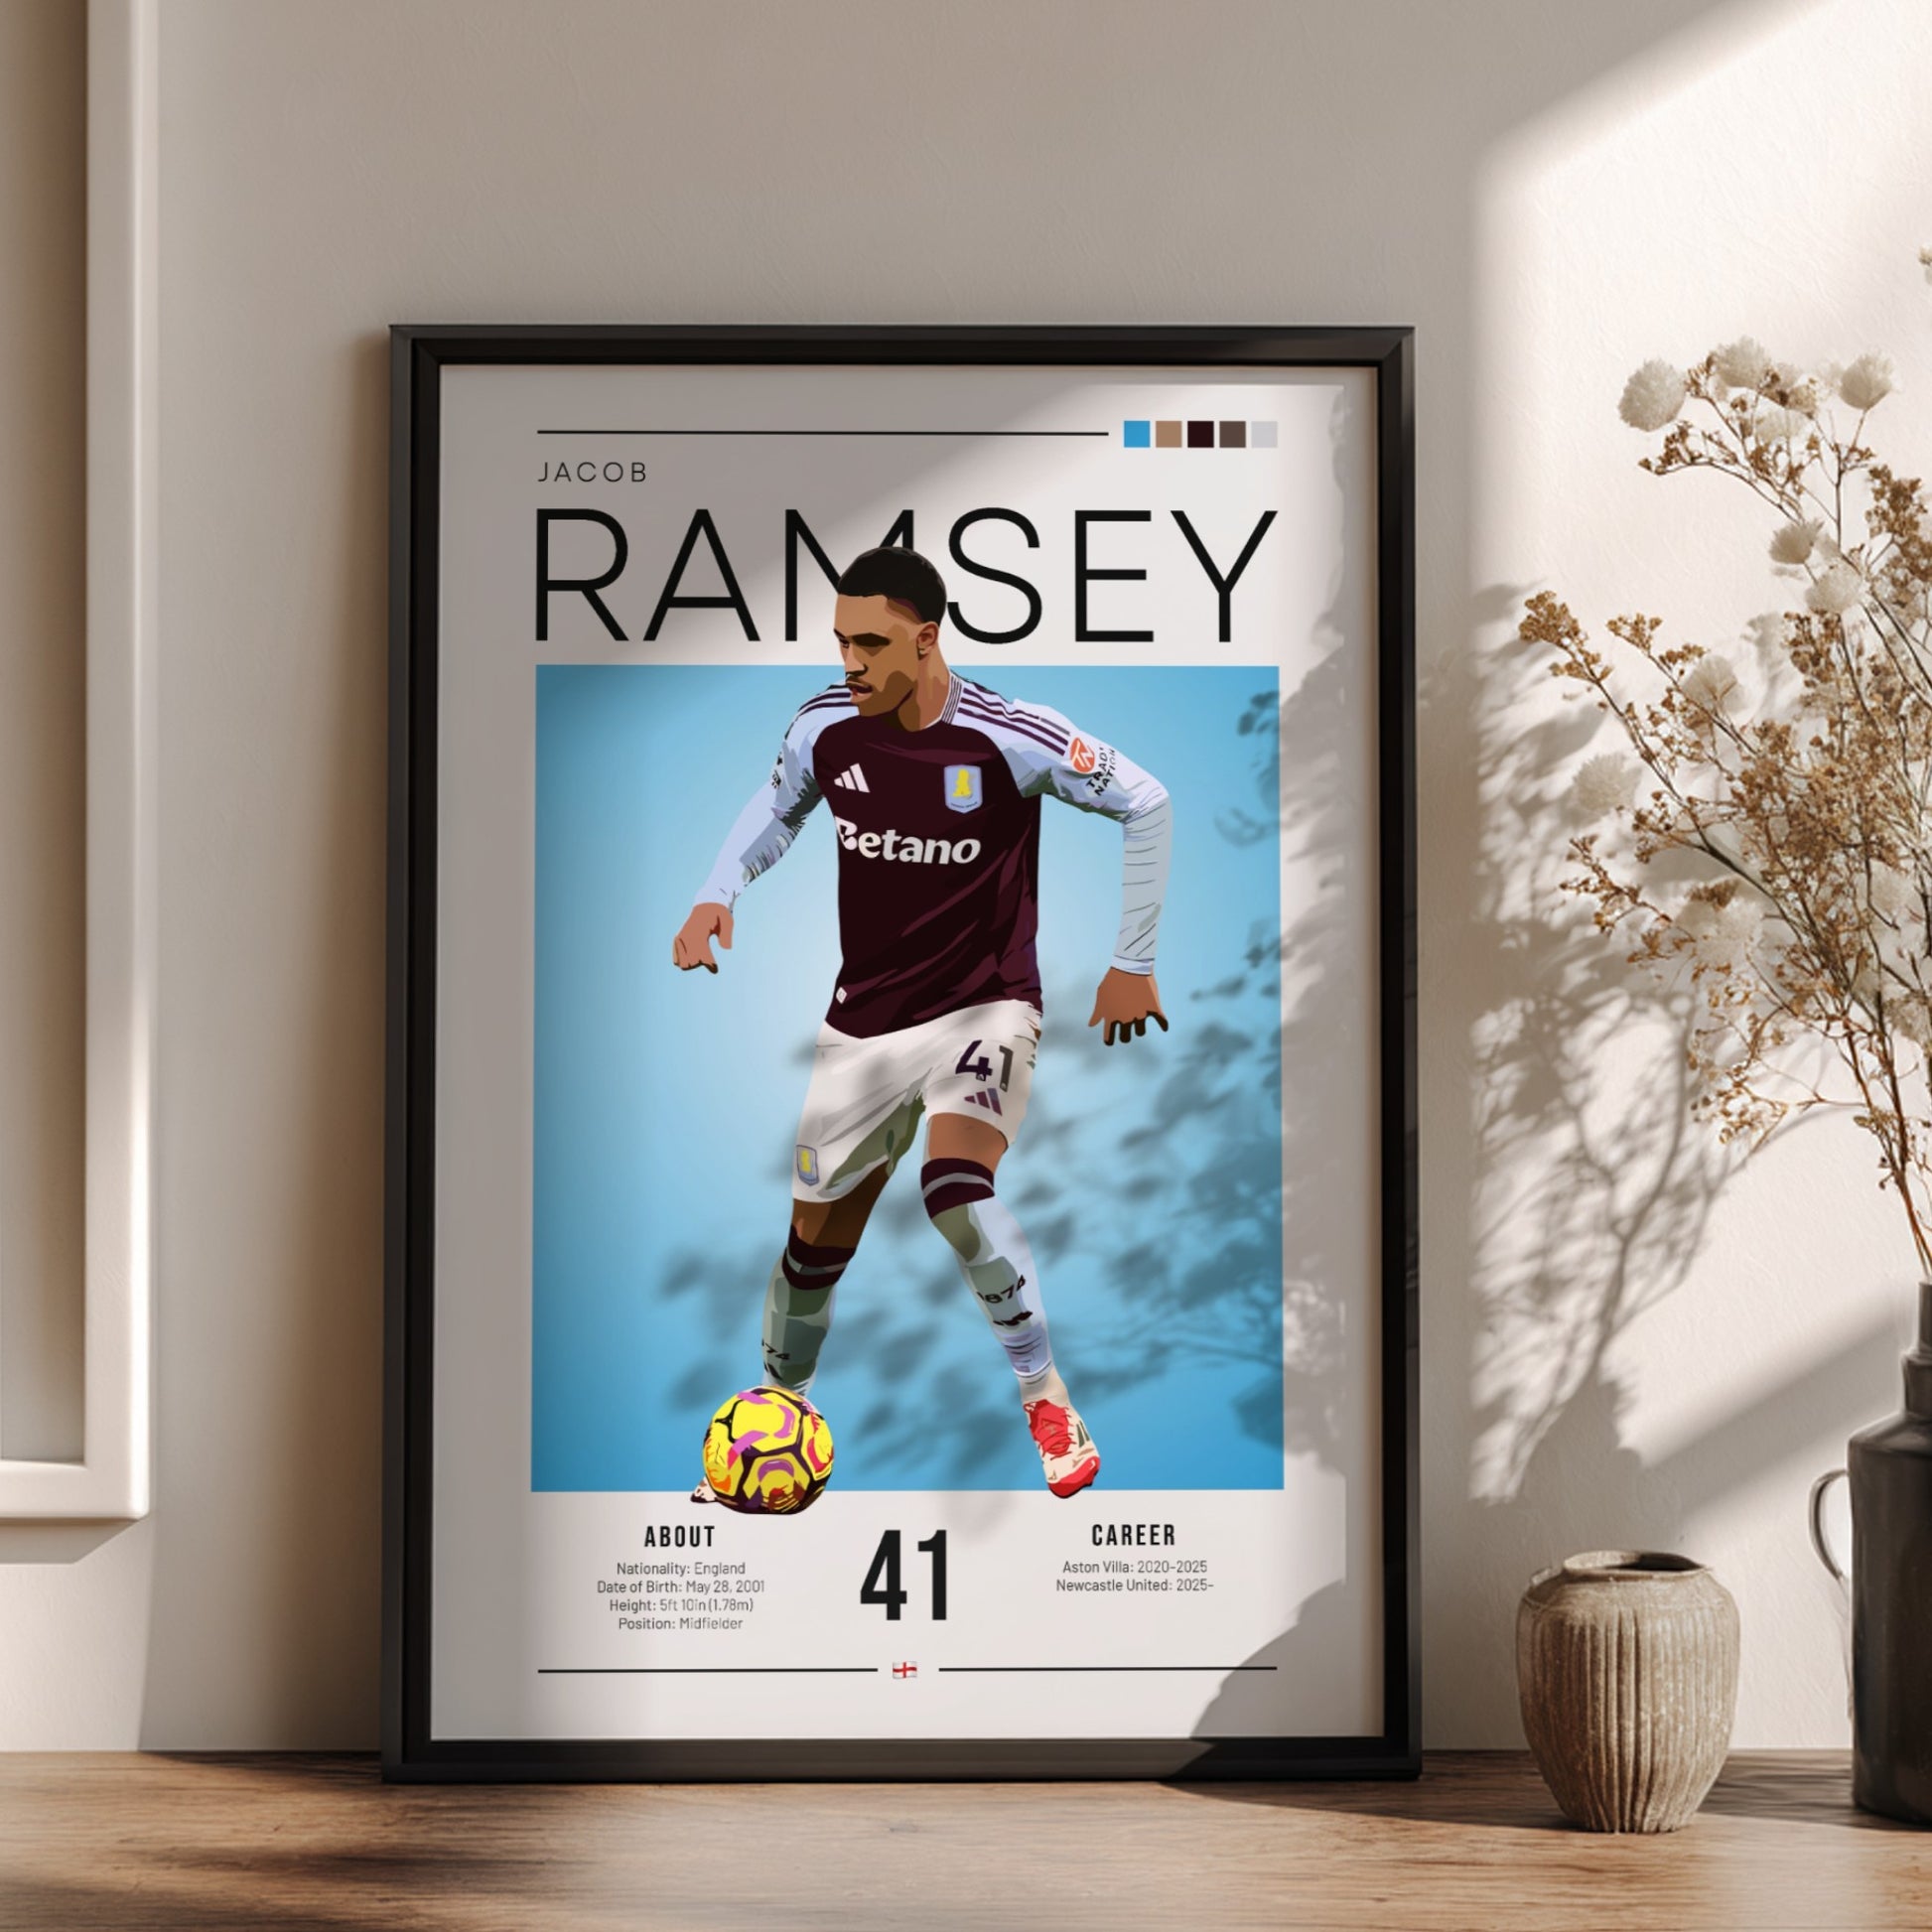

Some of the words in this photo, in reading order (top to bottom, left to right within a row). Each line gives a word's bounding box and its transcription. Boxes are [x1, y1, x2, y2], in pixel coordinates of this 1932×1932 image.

[537, 461, 646, 483] JACOB
[535, 507, 1278, 644] RAMSEY
[834, 815, 982, 865] Betano
[955, 1039, 1014, 1092] 41
[643, 1525, 716, 1548] ABOUT
[1091, 1524, 1175, 1547] CAREER
[616, 1562, 691, 1578] Nationality:
[694, 1562, 747, 1578] England
[859, 1529, 948, 1621] 41
[1062, 1560, 1100, 1574] Aston
[1102, 1560, 1135, 1574] Villa:
[1137, 1560, 1208, 1574] 2020-2025
[596, 1580, 627, 1593] Date
[628, 1580, 643, 1593] of
[645, 1580, 683, 1593] Birth:
[685, 1580, 712, 1595] May
[713, 1580, 734, 1594] 28,
[736, 1580, 765, 1593] 2001
[1055, 1579, 1124, 1592] Newcastle
[1126, 1579, 1173, 1592] United:
[1175, 1579, 1214, 1592] 2025-
[609, 1598, 657, 1614] Height:
[659, 1598, 678, 1612] 5ft
[618, 1617, 677, 1630] Position:
[679, 1617, 745, 1630] Midfielder
